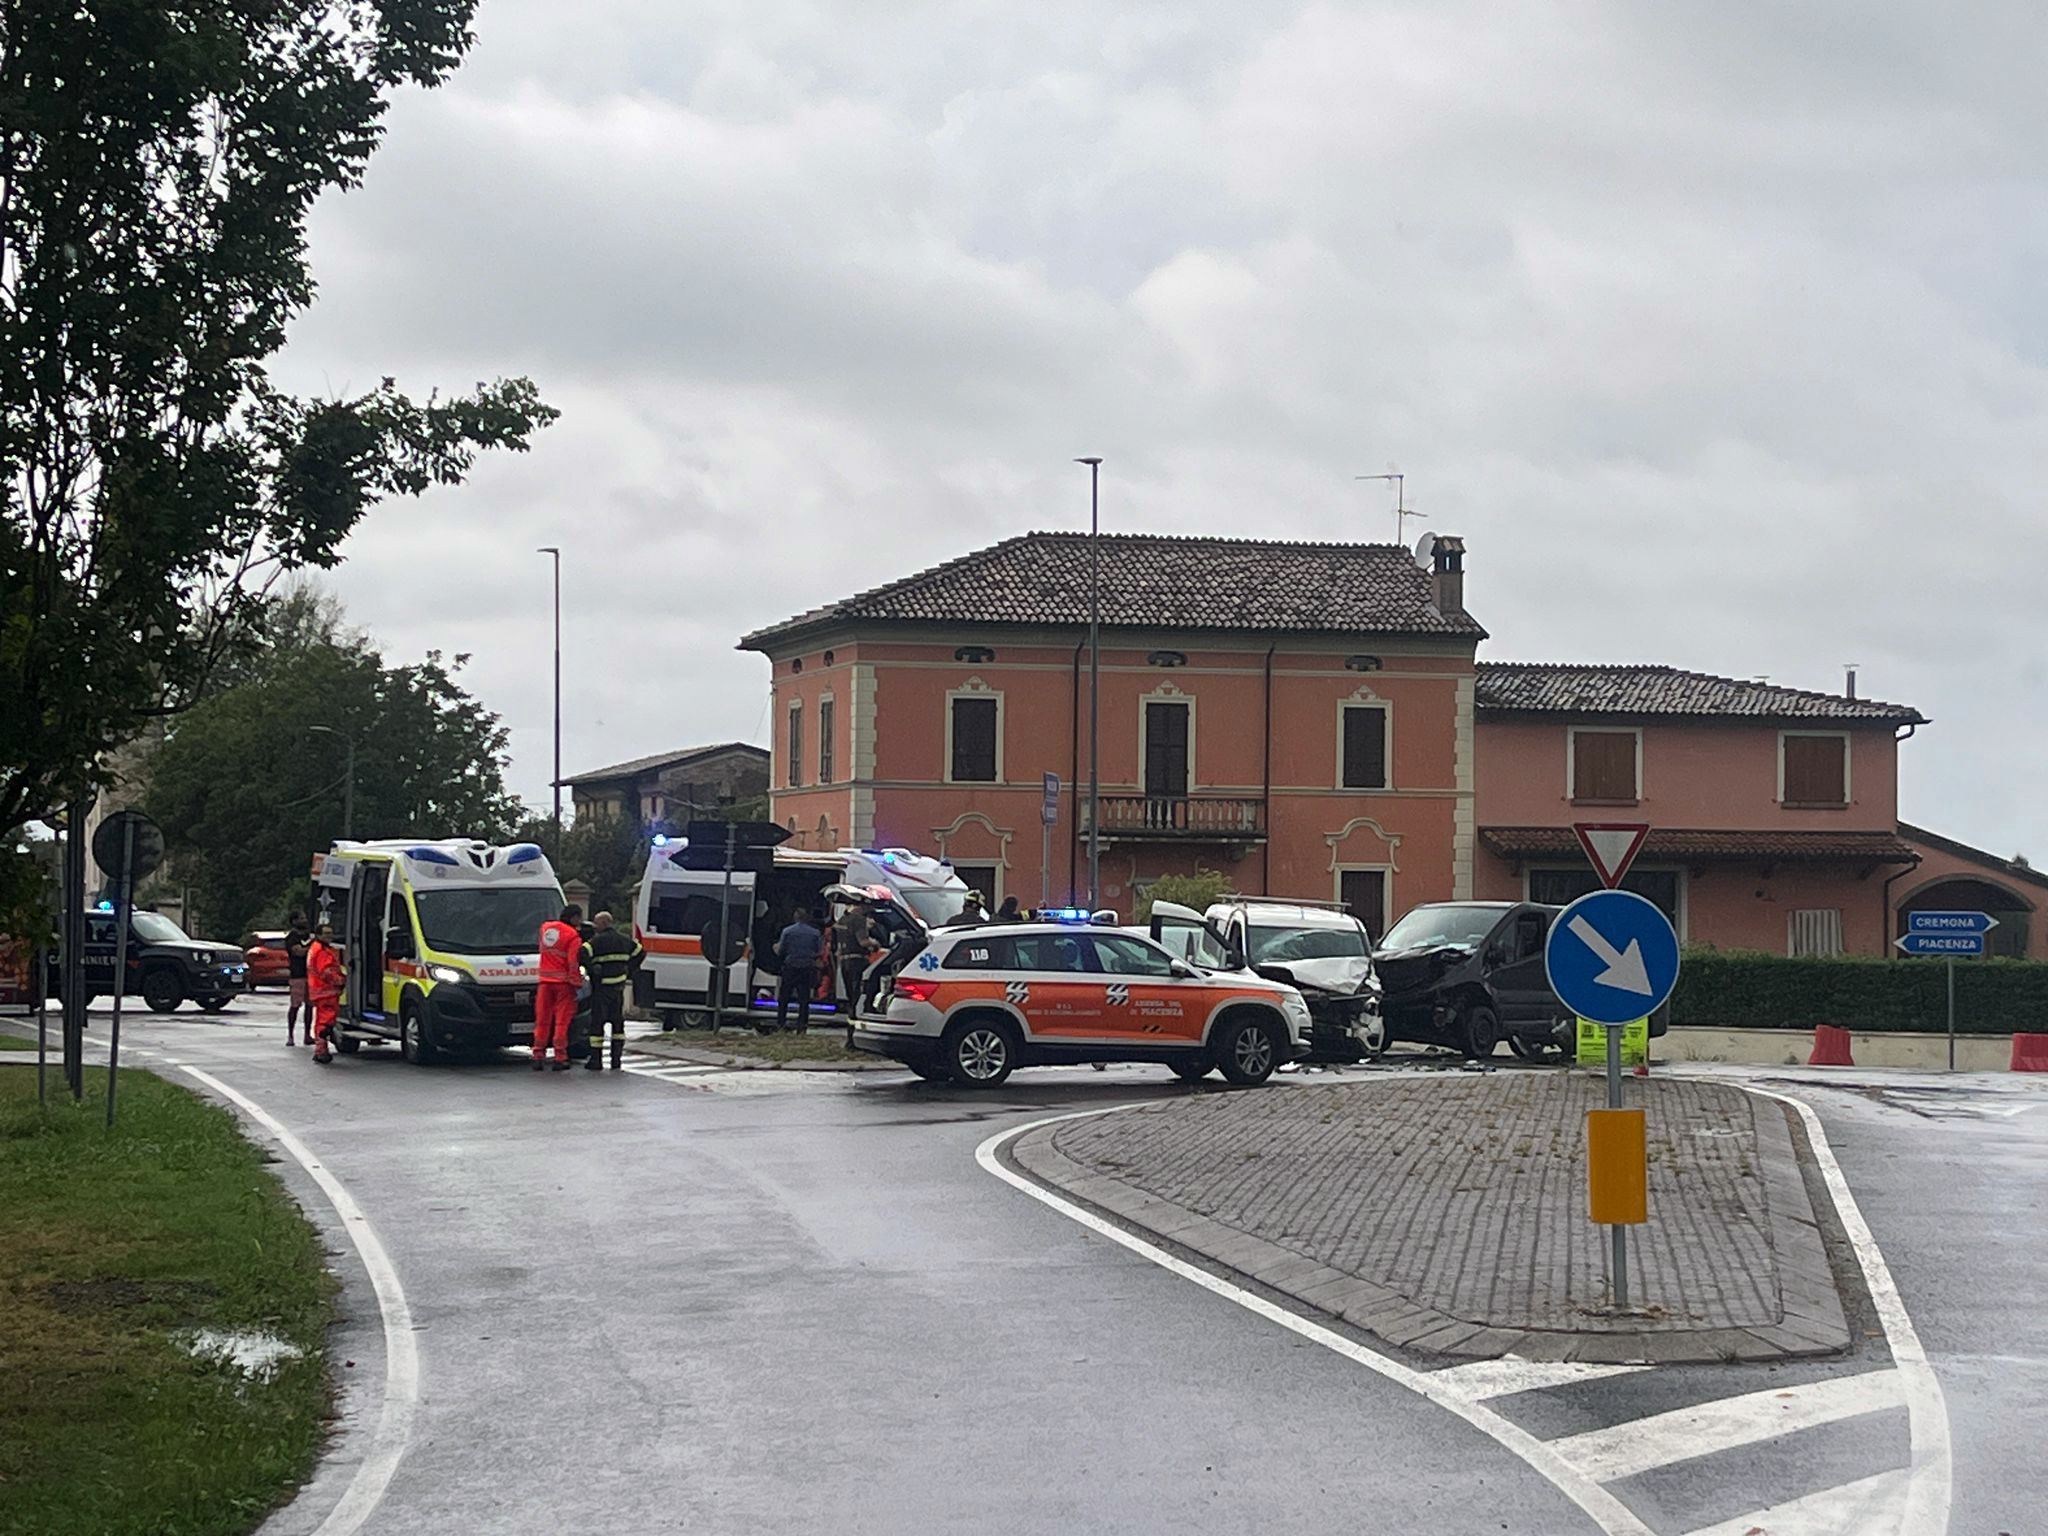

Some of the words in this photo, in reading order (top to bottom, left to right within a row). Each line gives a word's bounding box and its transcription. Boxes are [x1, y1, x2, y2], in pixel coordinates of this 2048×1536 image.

[1916, 917, 1975, 928] CREMONA
[1918, 938, 1976, 949] PIACENZA
[969, 948, 989, 961] 118
